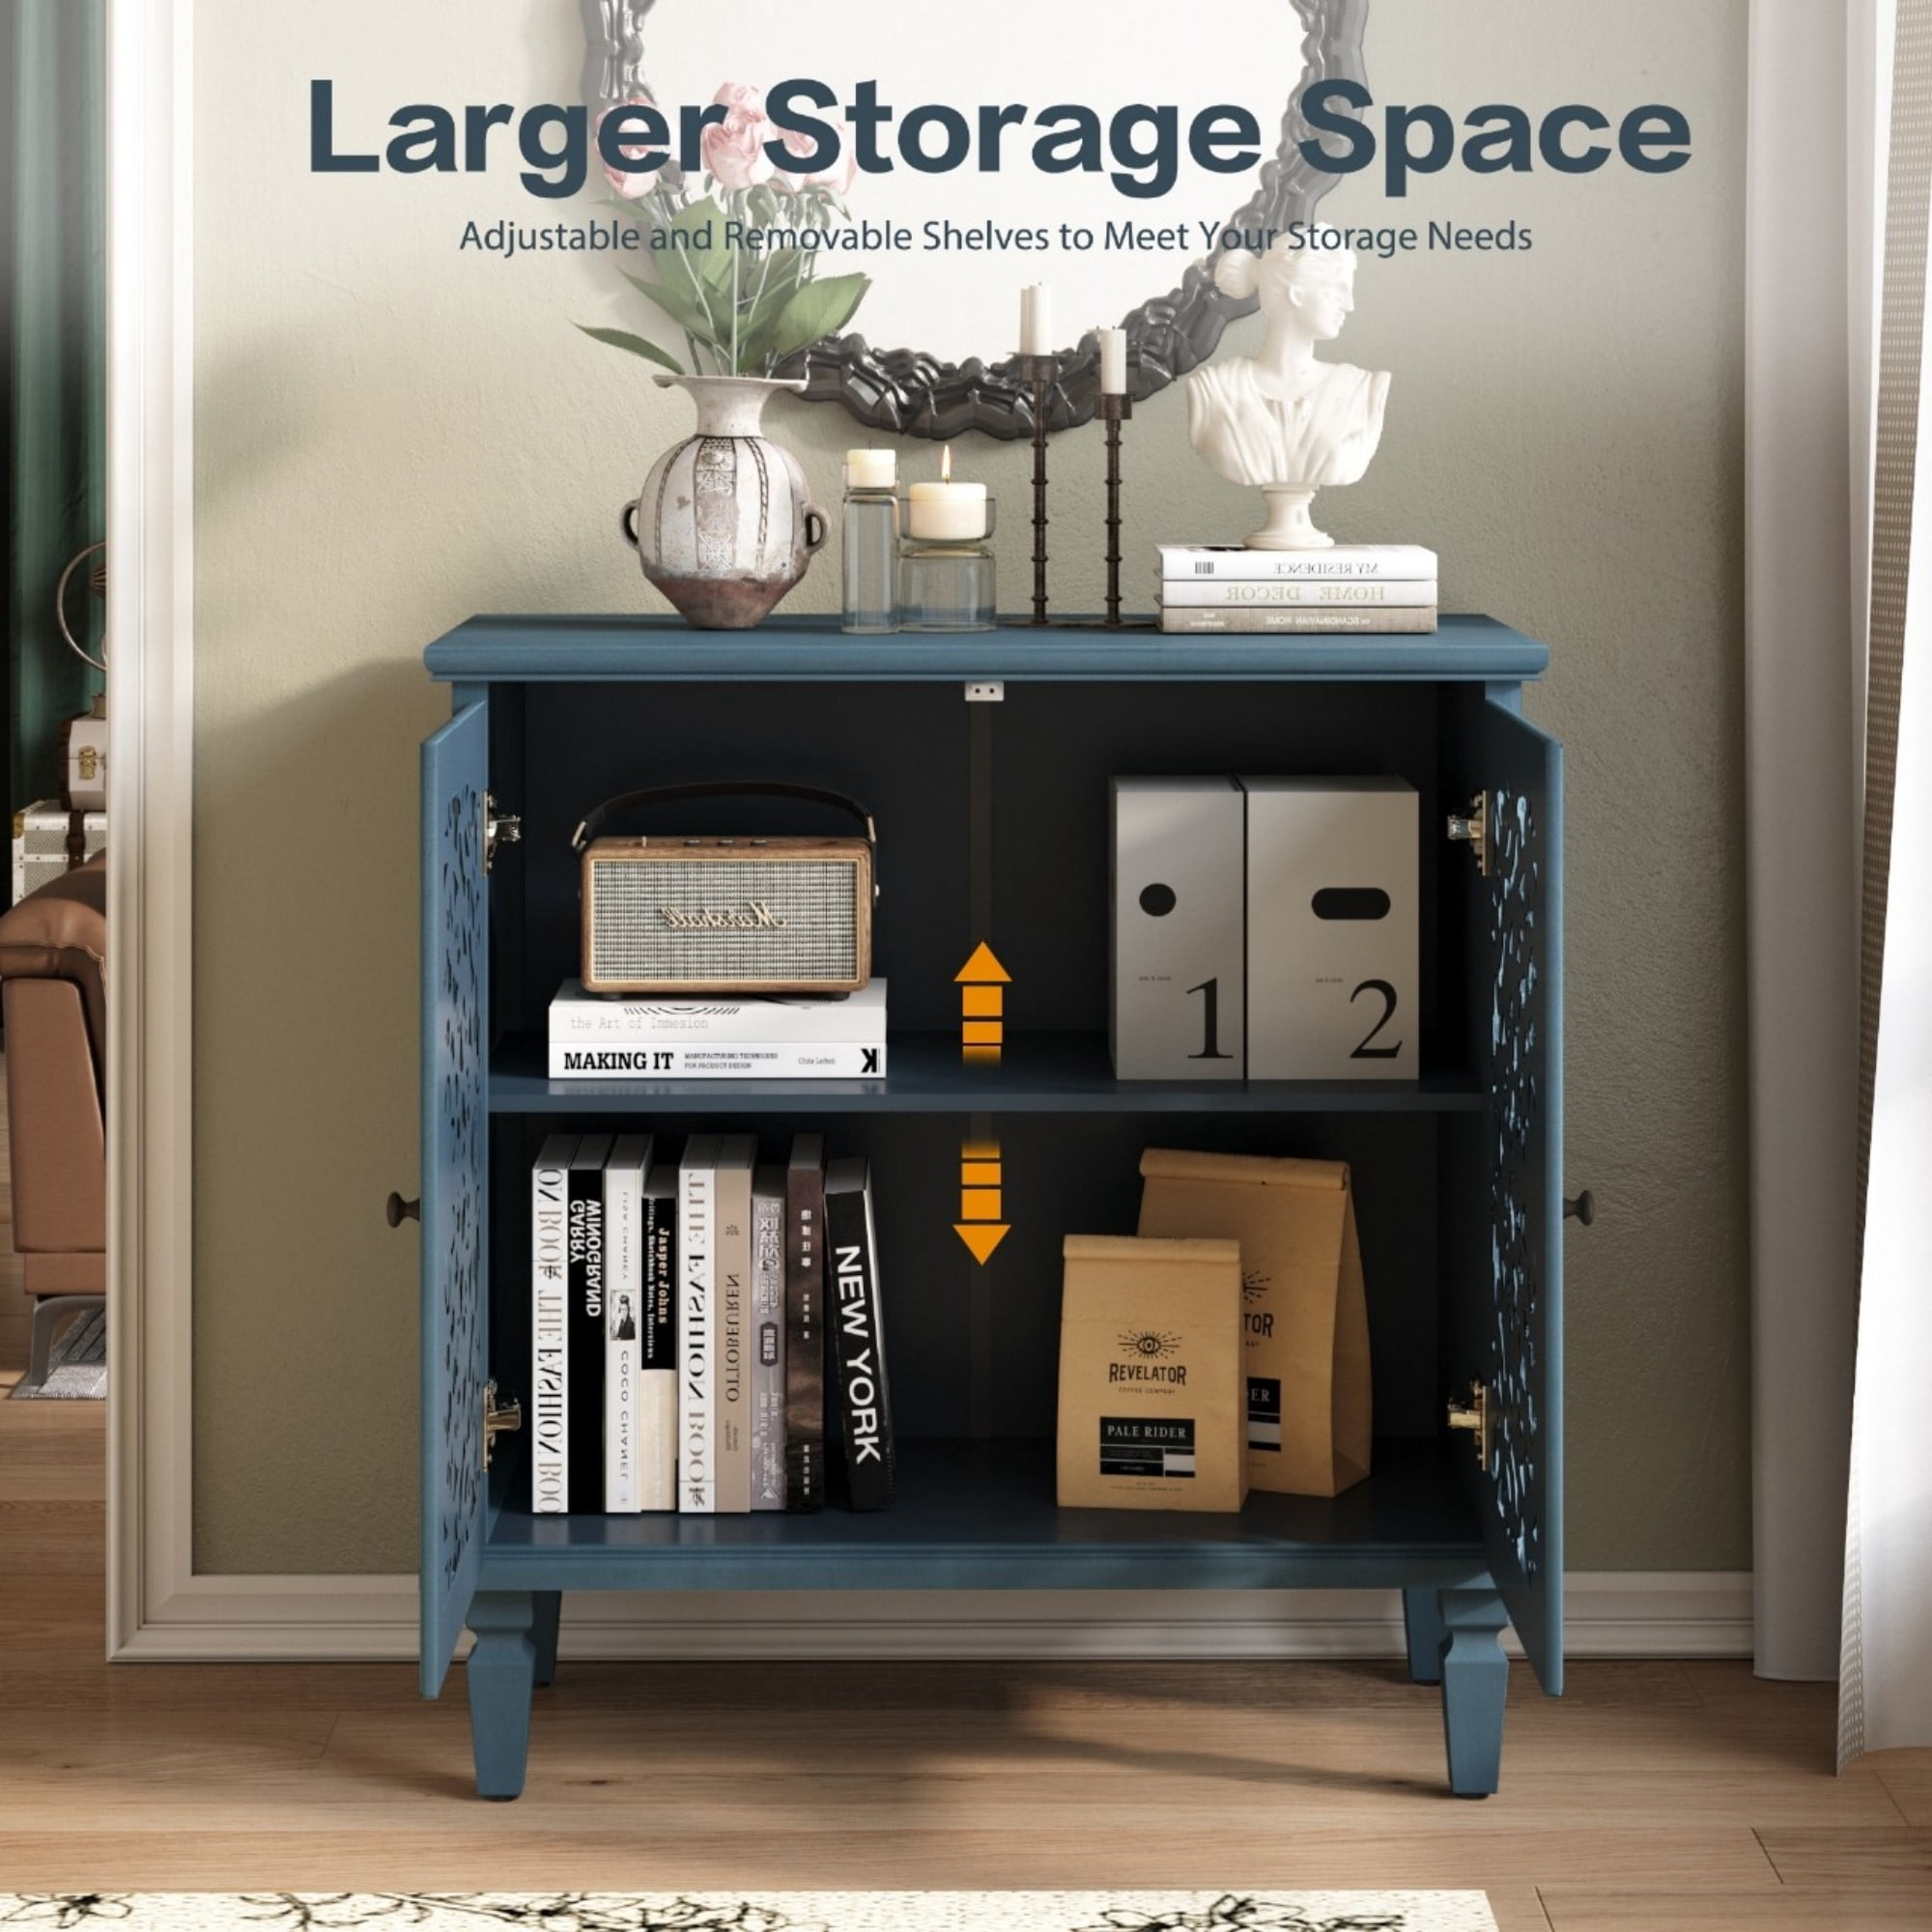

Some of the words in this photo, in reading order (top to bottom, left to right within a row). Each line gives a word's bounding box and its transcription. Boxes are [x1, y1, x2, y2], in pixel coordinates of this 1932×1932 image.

[571, 1015, 592, 1029] the
[598, 1015, 621, 1029] Art
[629, 1015, 642, 1029] of
[1186, 977, 1235, 1059] 1
[1349, 979, 1404, 1059] 2
[564, 1052, 647, 1070] MAKING
[653, 1052, 674, 1070] IT
[655, 1228, 670, 1277] Jasper
[657, 1280, 670, 1324] Johns
[835, 1245, 869, 1339] NEW
[1108, 1362, 1187, 1386] REVELATOR
[846, 1350, 881, 1465] YORK
[1107, 1425, 1140, 1438] PALE
[1144, 1426, 1187, 1439] RIDER
